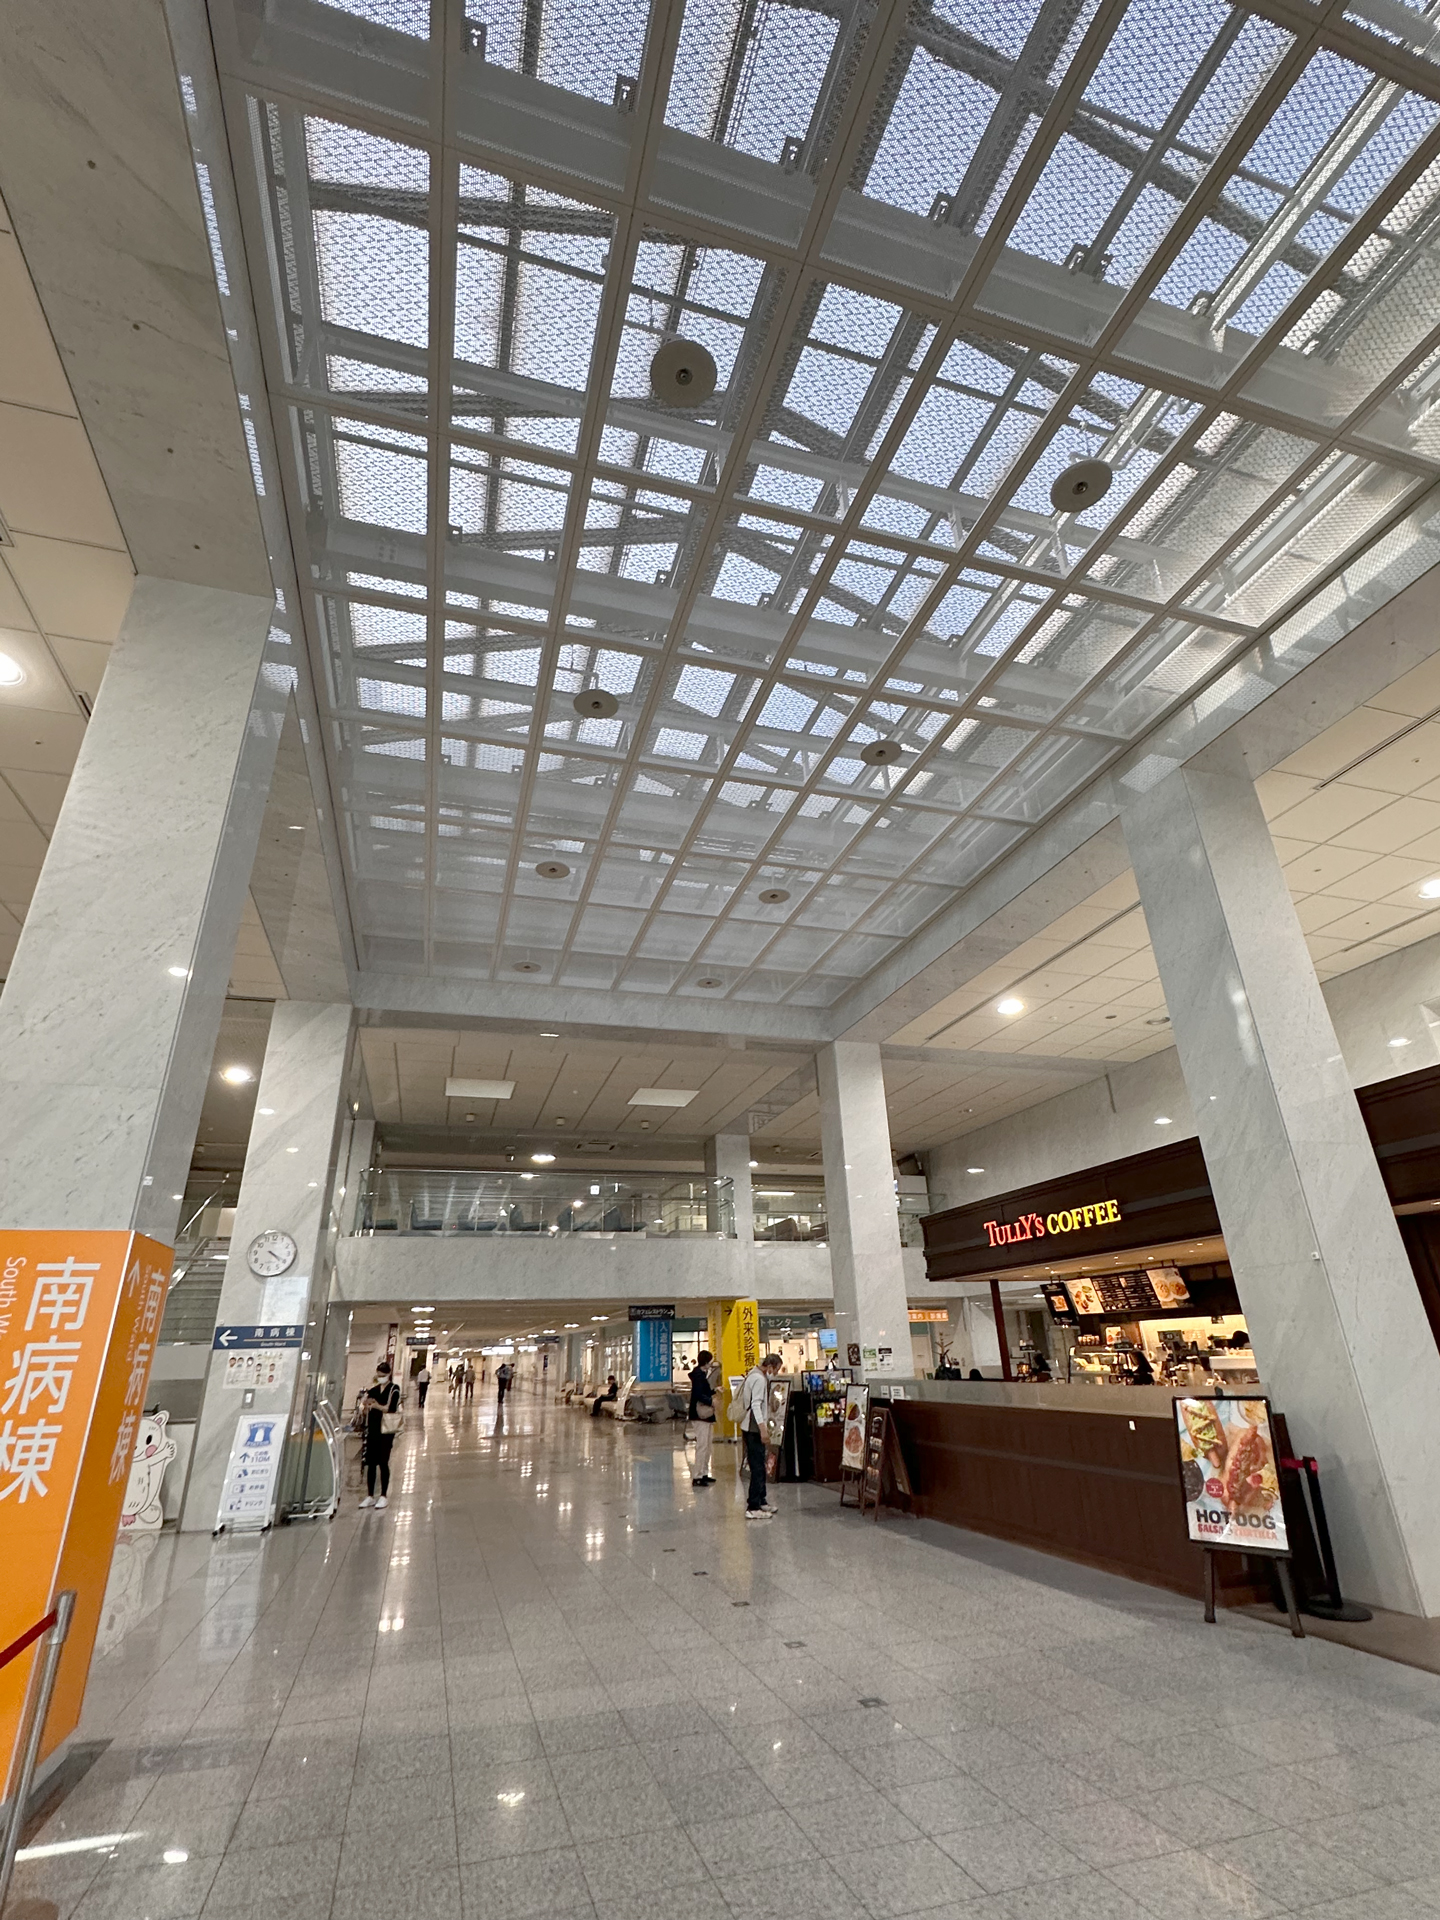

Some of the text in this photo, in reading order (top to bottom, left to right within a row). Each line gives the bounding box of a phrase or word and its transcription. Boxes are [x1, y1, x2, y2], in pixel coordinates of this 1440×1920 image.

[1046, 1199, 1121, 1235] COFFEE
[272, 1234, 279, 1242] 12
[254, 1327, 295, 1338] 南病棟
[0, 1256, 101, 1504] 南病棟
[107, 1268, 165, 1486] 南病棟
[1195, 1508, 1276, 1530] HOT DOG
